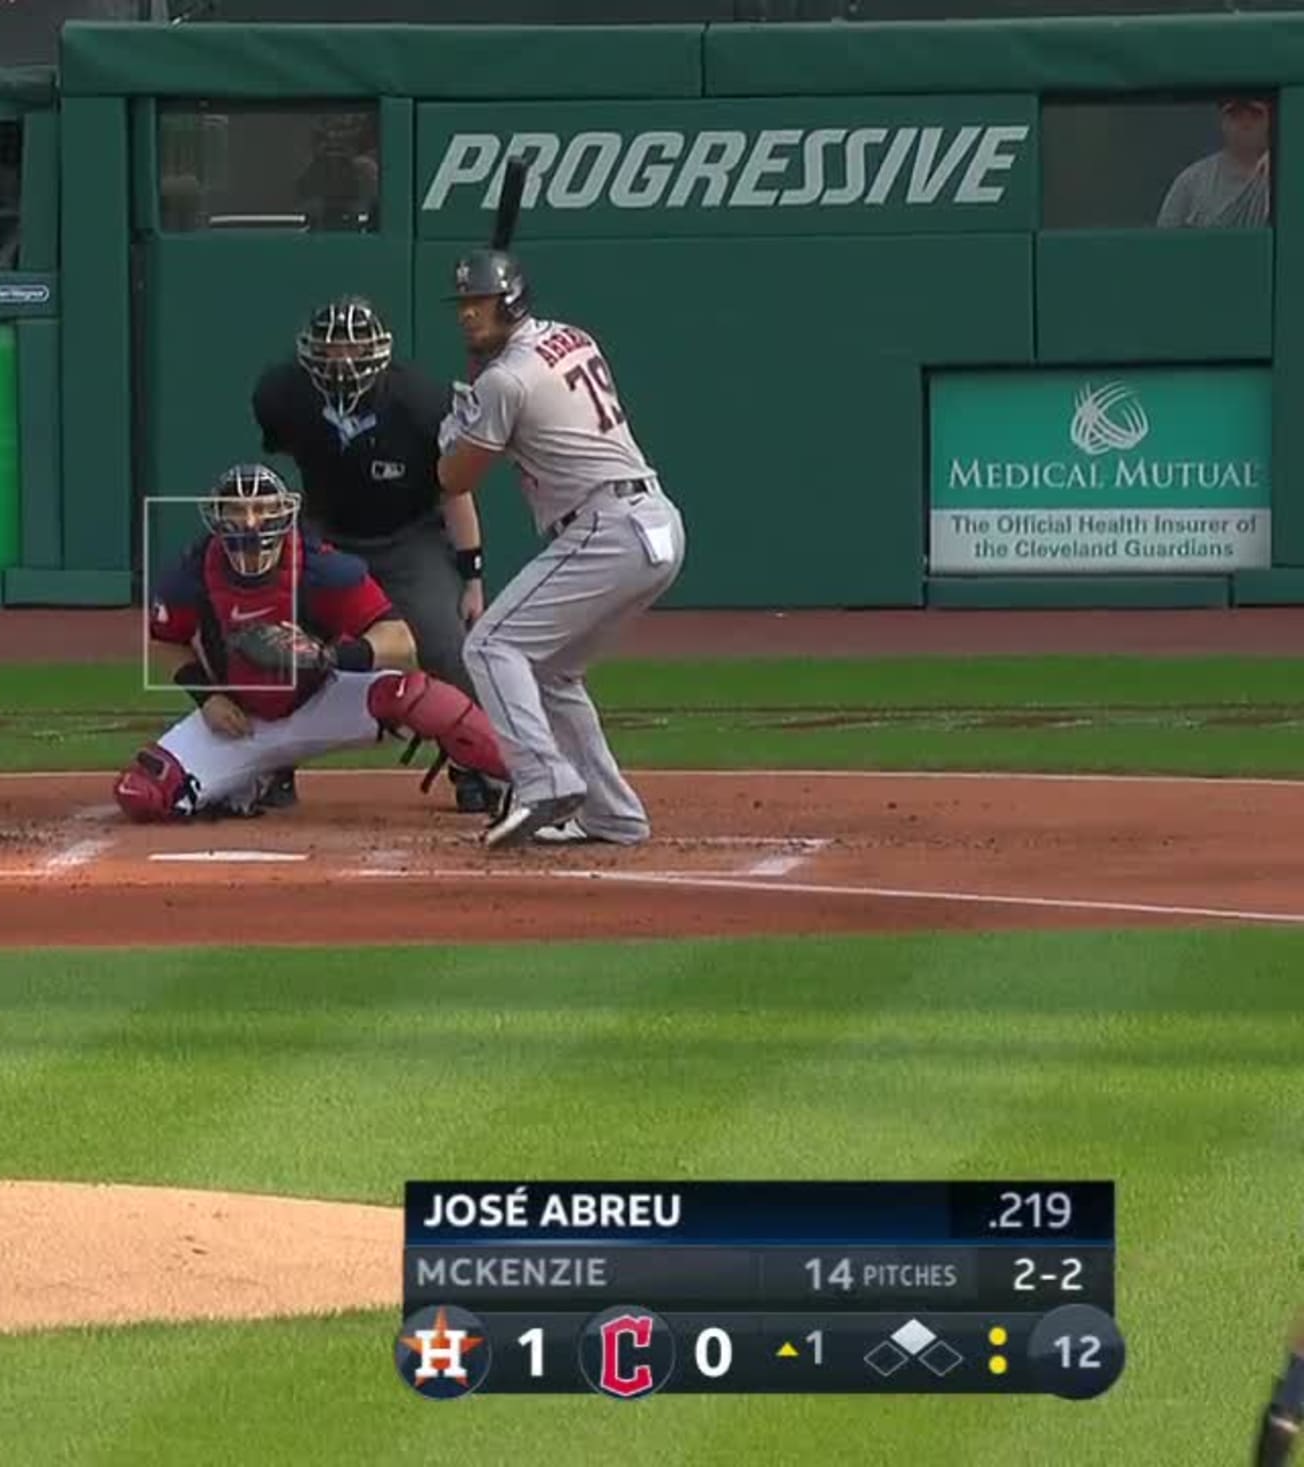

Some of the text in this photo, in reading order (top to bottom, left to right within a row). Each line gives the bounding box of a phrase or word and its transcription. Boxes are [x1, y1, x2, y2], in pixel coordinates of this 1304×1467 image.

[421, 125, 1030, 211] PROGRESSIVE
[563, 355, 624, 434] 79
[949, 457, 1260, 489] MEDICAL MUTUAL
[952, 514, 1257, 535] The Official Health Insurer of
[974, 539, 1234, 559] the Cleveland Guardians
